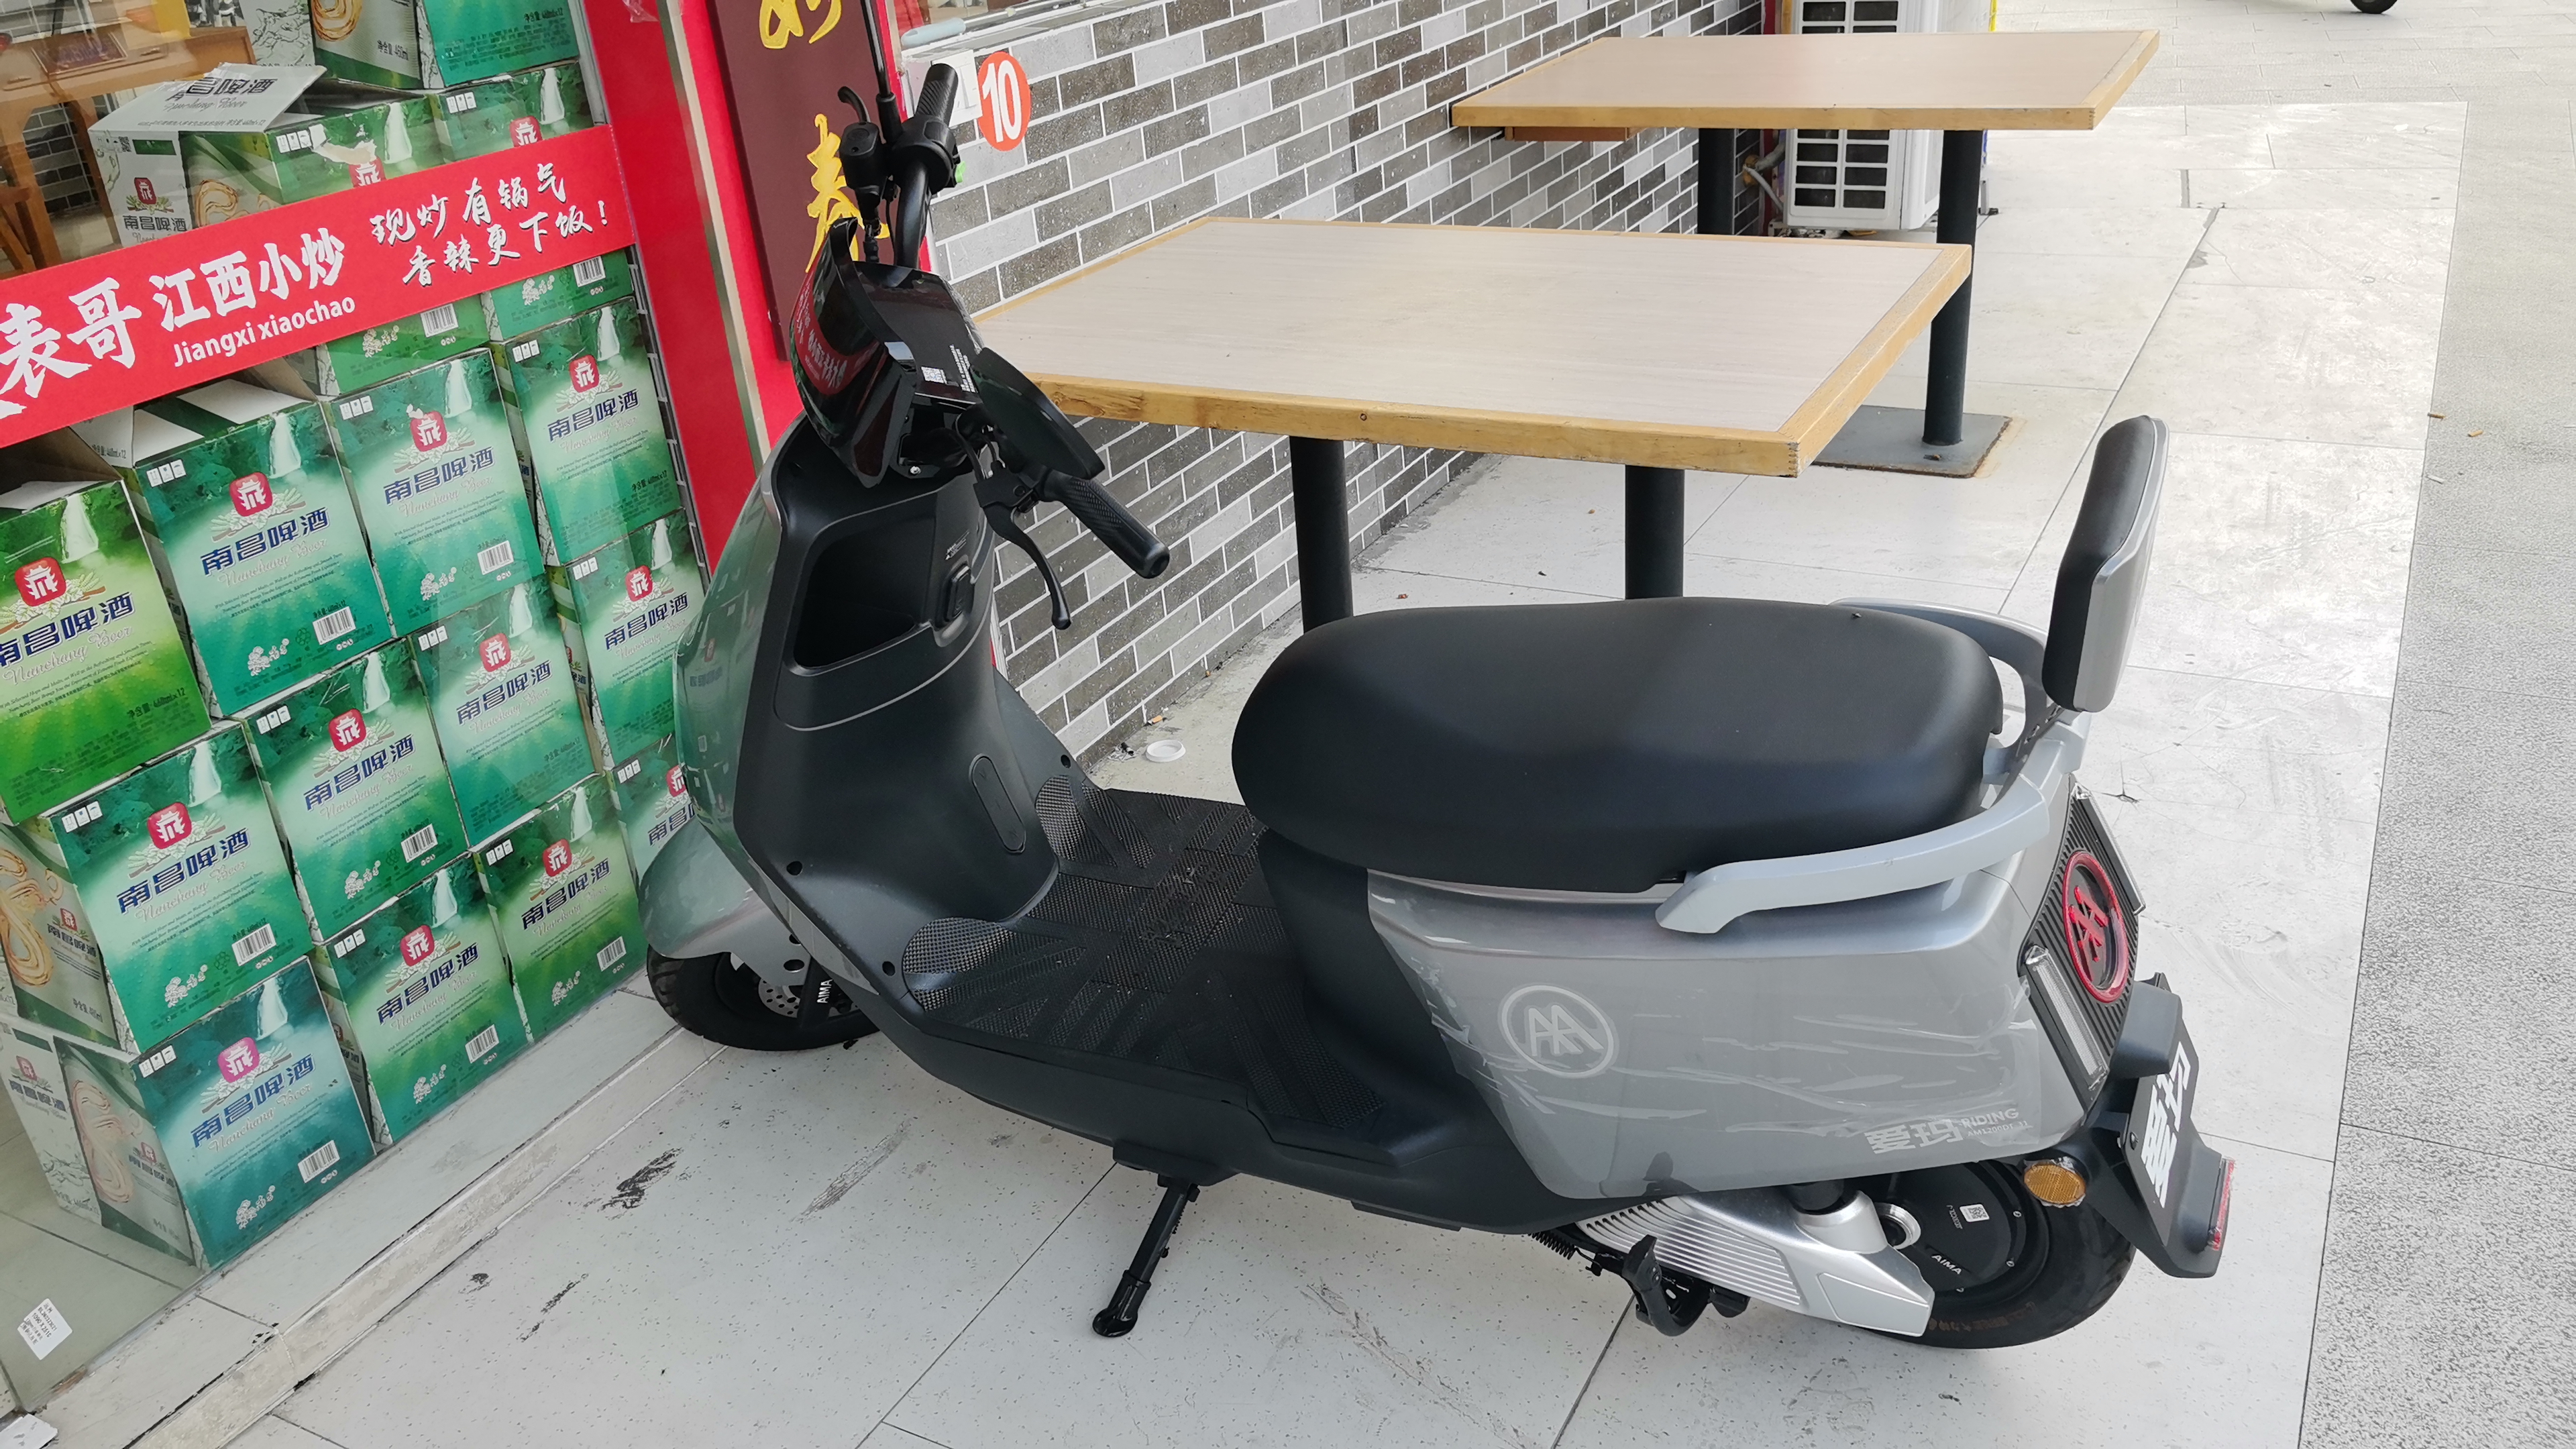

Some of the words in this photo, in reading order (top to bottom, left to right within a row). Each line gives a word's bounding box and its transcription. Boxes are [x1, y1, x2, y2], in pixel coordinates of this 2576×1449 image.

[982, 60, 1020, 144] 10
[123, 215, 187, 232] 南昌啤酒
[370, 162, 567, 246] 现炒有锅气
[149, 228, 345, 332] 江西小炒
[174, 322, 255, 368] Jiangxi
[260, 296, 356, 340] xiaochao
[547, 389, 640, 443] 南昌啤酒
[384, 447, 496, 506] 南昌啤酒
[201, 508, 330, 577] 南昌啤酒
[604, 592, 689, 651] 南昌啤酒
[456, 660, 553, 725] 南昌啤酒
[304, 734, 417, 812] 南昌啤酒
[647, 804, 696, 847] 南昌
[117, 828, 251, 915] 南昌啤酒
[522, 859, 612, 930] 南昌啤酒
[377, 943, 481, 1025] 南昌啤酒
[817, 979, 833, 1004] AIMA
[191, 1054, 315, 1148] 南昌啤酒
[1961, 1108, 2019, 1128] RIDING
[1864, 1118, 1964, 1155] 爱玛
[1931, 1253, 1962, 1275] AIMA
